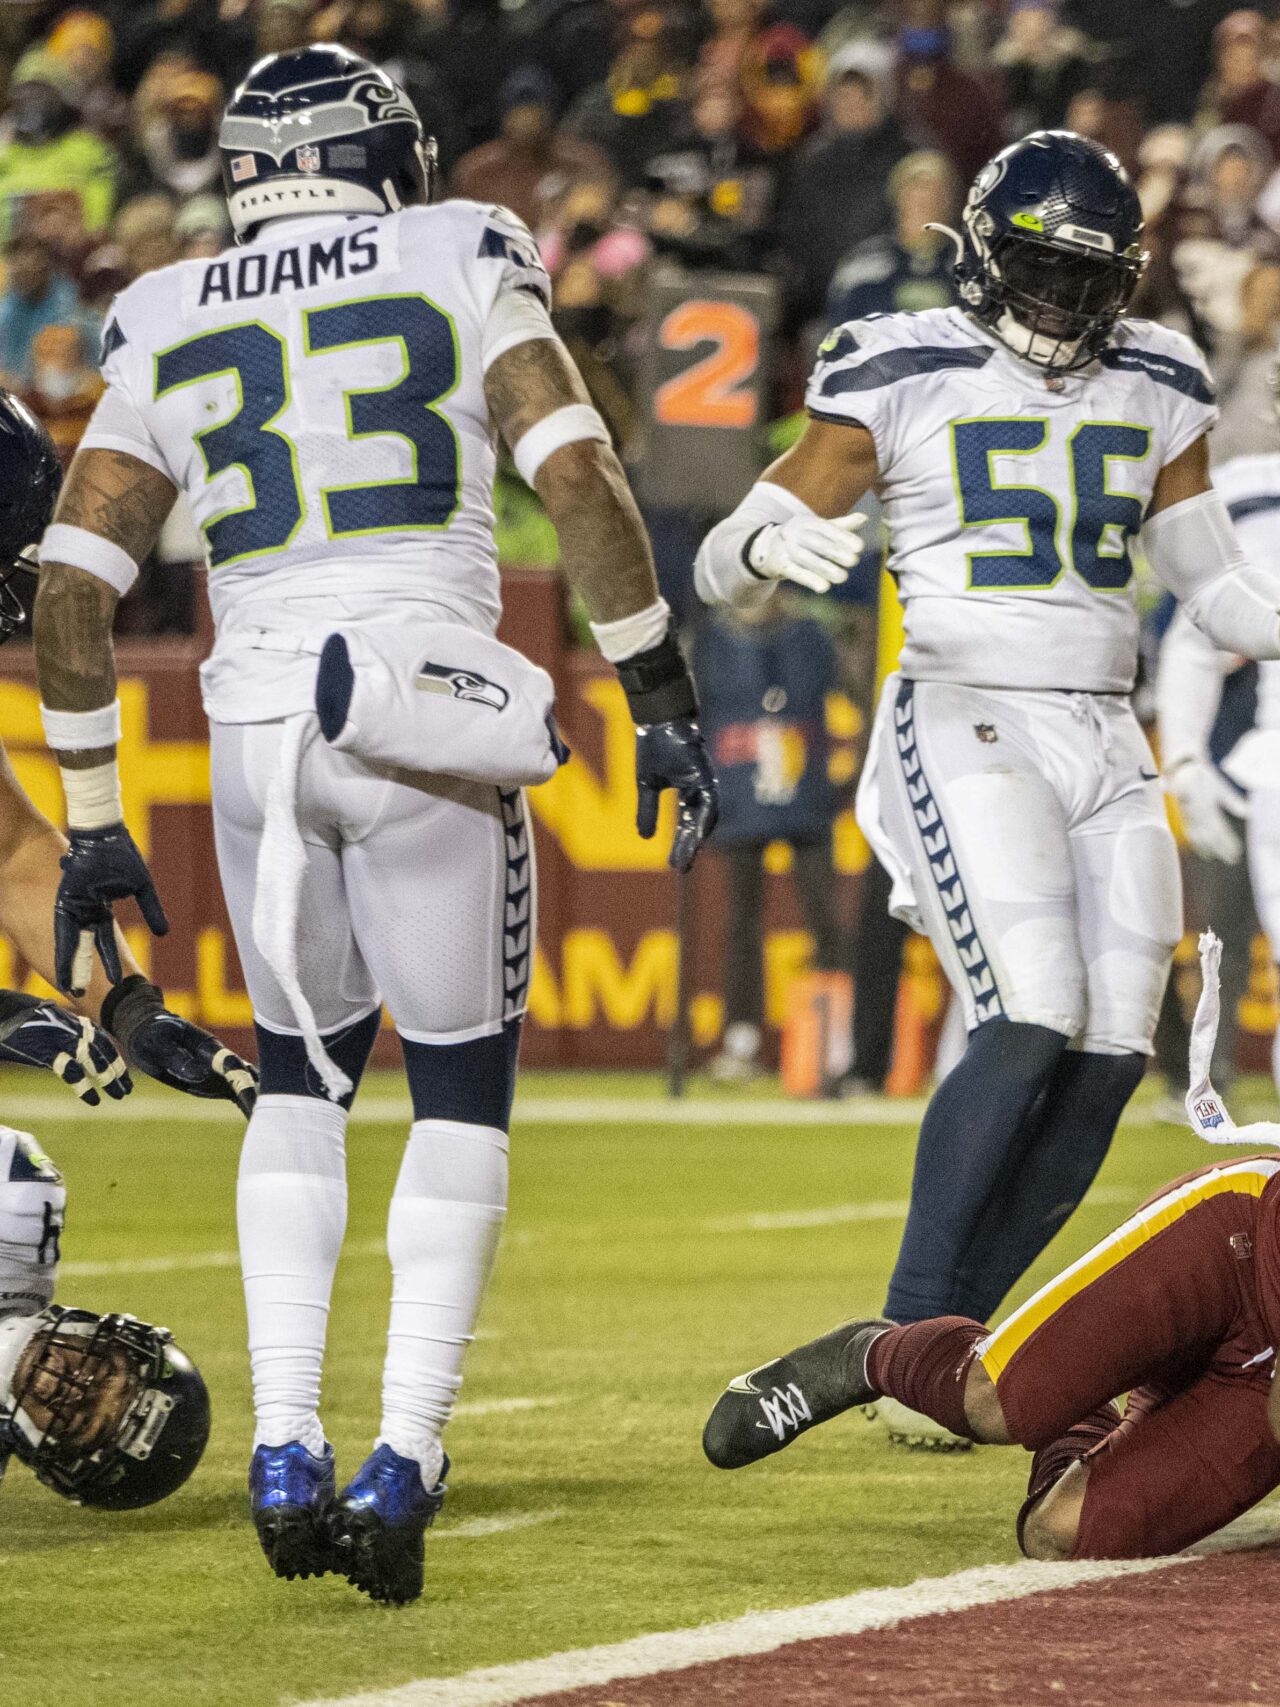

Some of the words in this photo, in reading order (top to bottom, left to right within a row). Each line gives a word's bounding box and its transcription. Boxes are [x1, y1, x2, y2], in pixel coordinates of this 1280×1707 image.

[240, 188, 336, 210] SEATTLE
[198, 226, 378, 306] ADAMS
[655, 302, 758, 428] 2
[152, 292, 462, 569] 33
[949, 417, 1153, 593] 56
